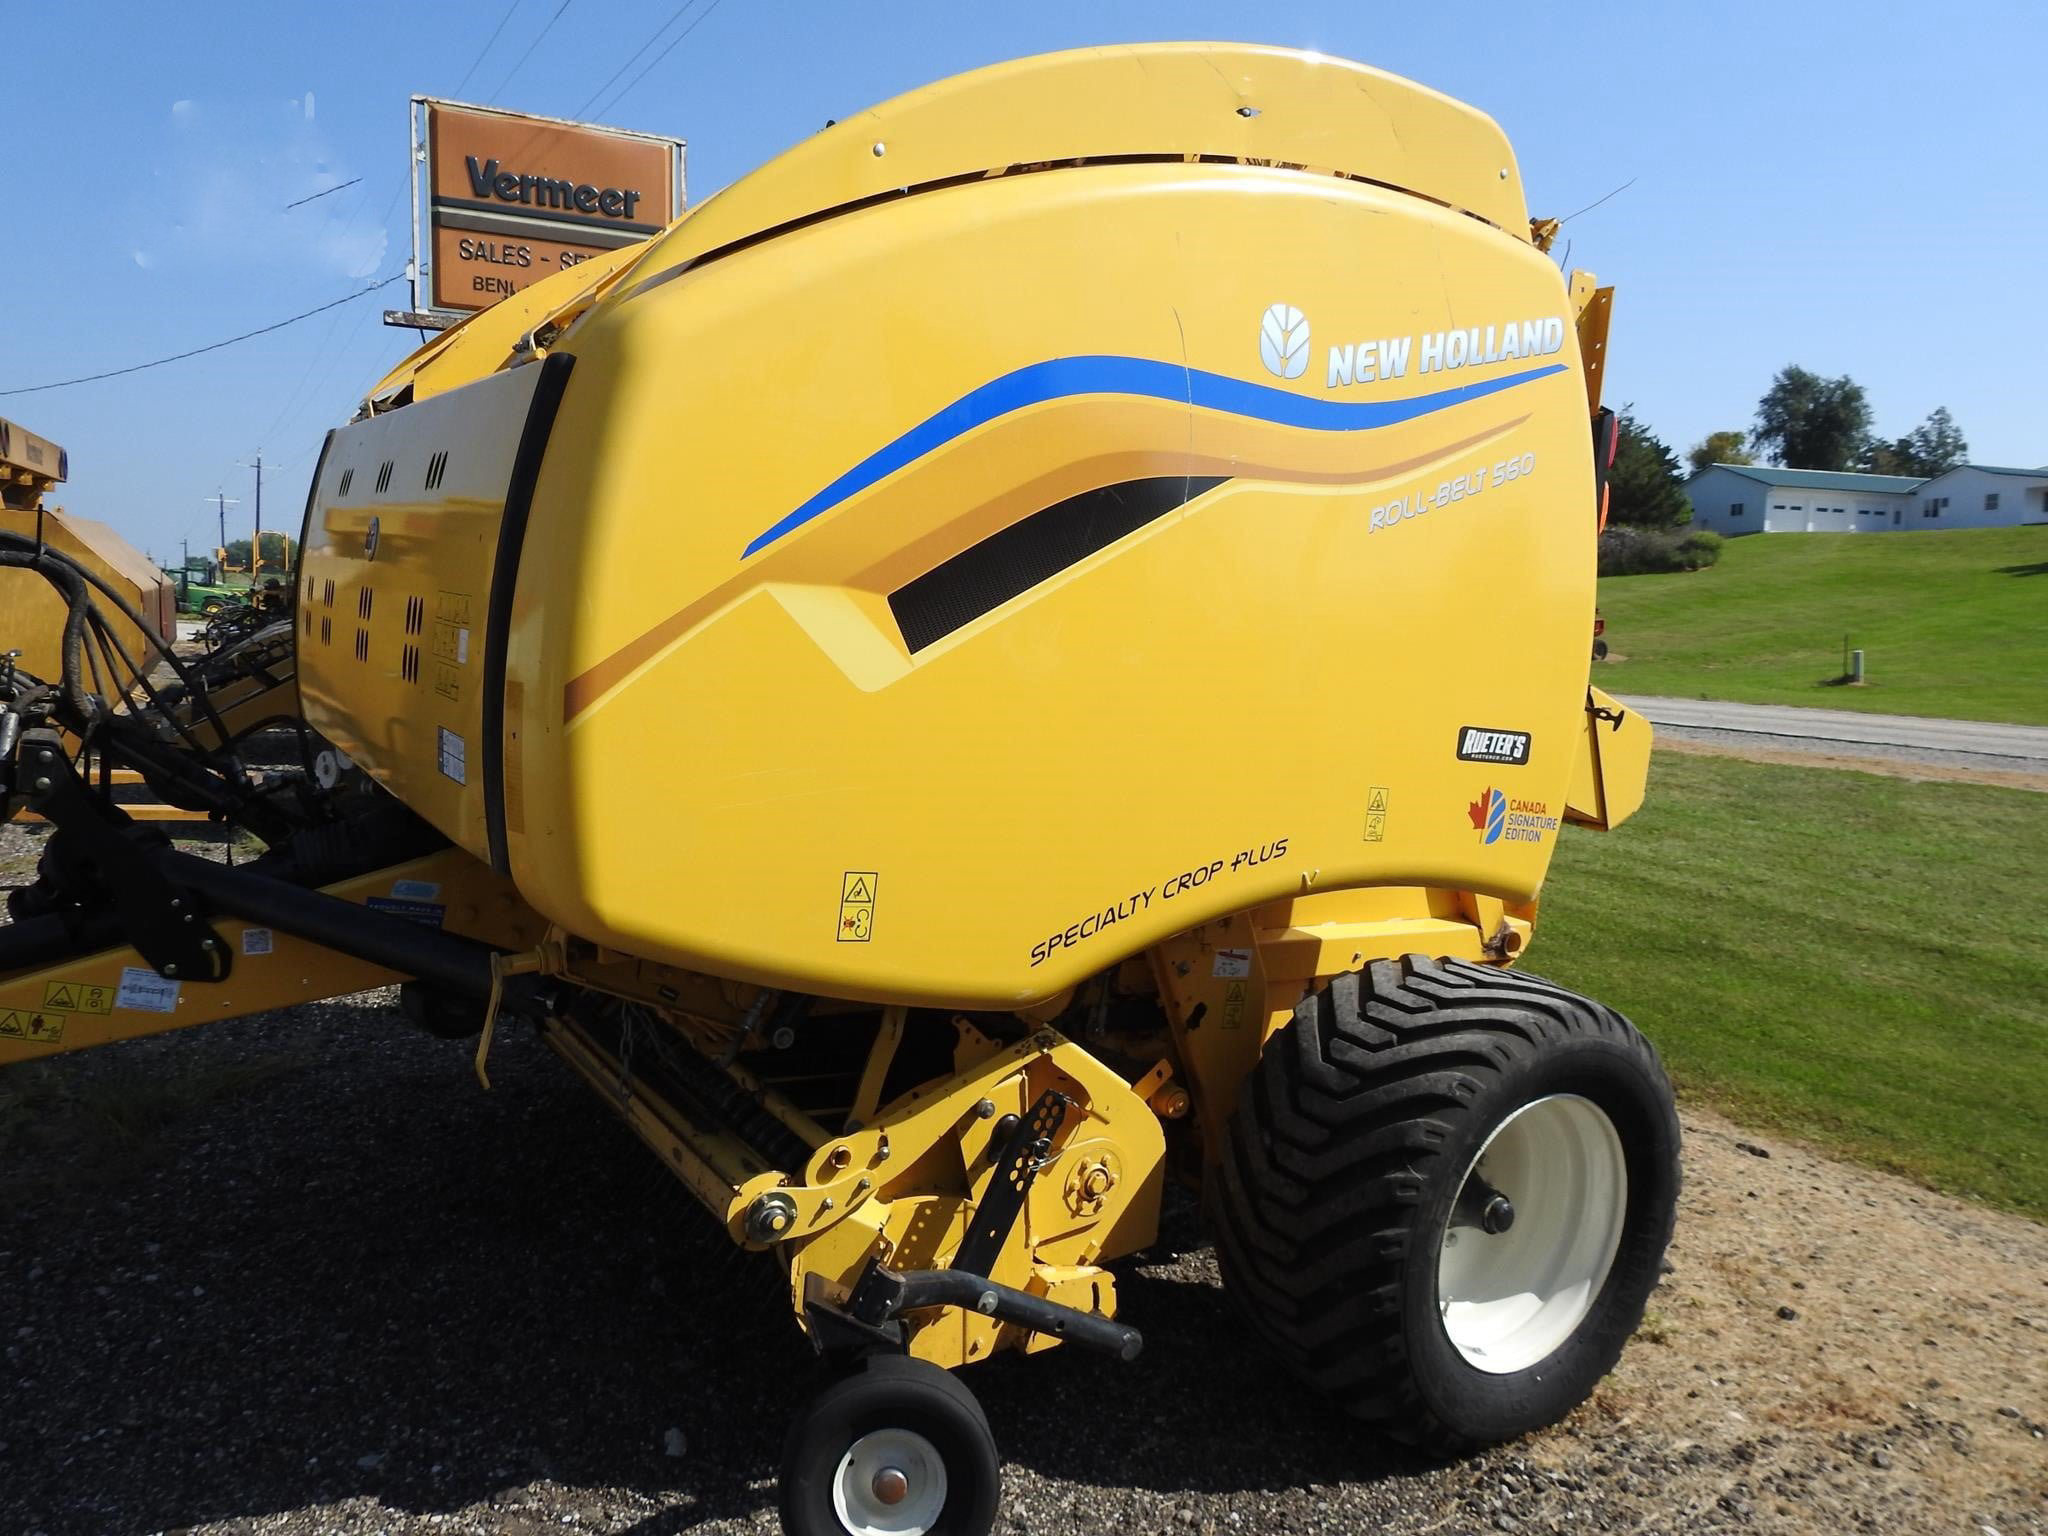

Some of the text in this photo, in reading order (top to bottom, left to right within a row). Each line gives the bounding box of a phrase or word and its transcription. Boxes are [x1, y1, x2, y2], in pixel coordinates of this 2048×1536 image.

[465, 156, 640, 219] Vermeer
[459, 238, 531, 268] SALES
[1327, 317, 1564, 388] NEW HOLLAND
[1368, 451, 1536, 534] ROLL-BELT 560
[1461, 729, 1527, 758] RUETER'S
[1507, 813, 1558, 830] SIGNATURE
[1509, 799, 1546, 815] CANADA
[1504, 827, 1541, 842] EDITION
[1030, 838, 1289, 968] SPECIALTY CROP PLUS
